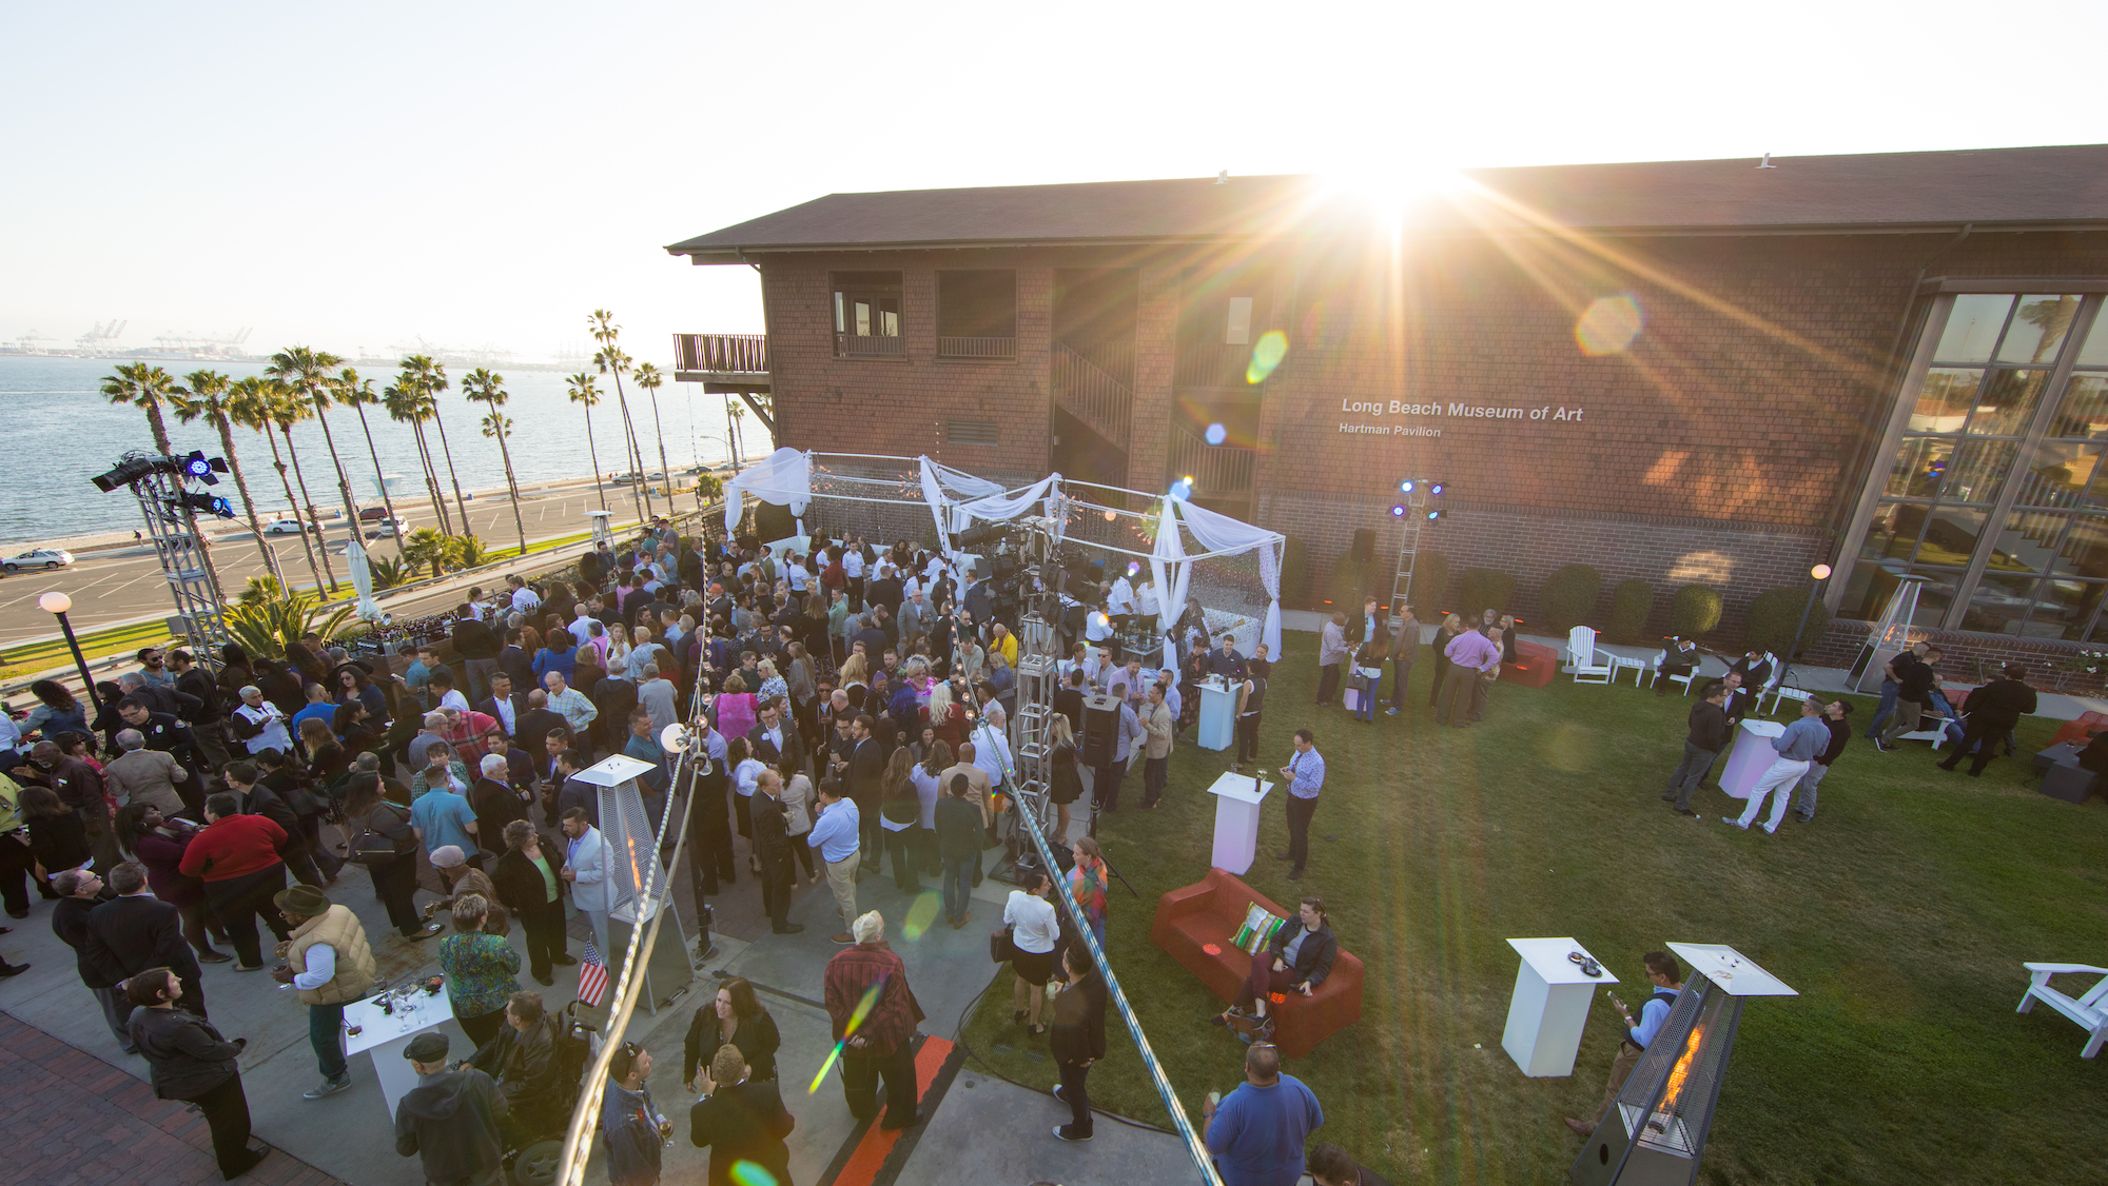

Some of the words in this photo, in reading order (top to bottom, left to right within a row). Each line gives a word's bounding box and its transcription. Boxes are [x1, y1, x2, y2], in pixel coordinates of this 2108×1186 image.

[1342, 398, 1383, 416] Long
[1389, 400, 1442, 415] Beach
[1447, 402, 1523, 419] Museum
[1529, 406, 1549, 420] of
[1552, 406, 1583, 421] Art
[1339, 423, 1390, 435] Hartman
[1393, 425, 1441, 437] Pavilion
